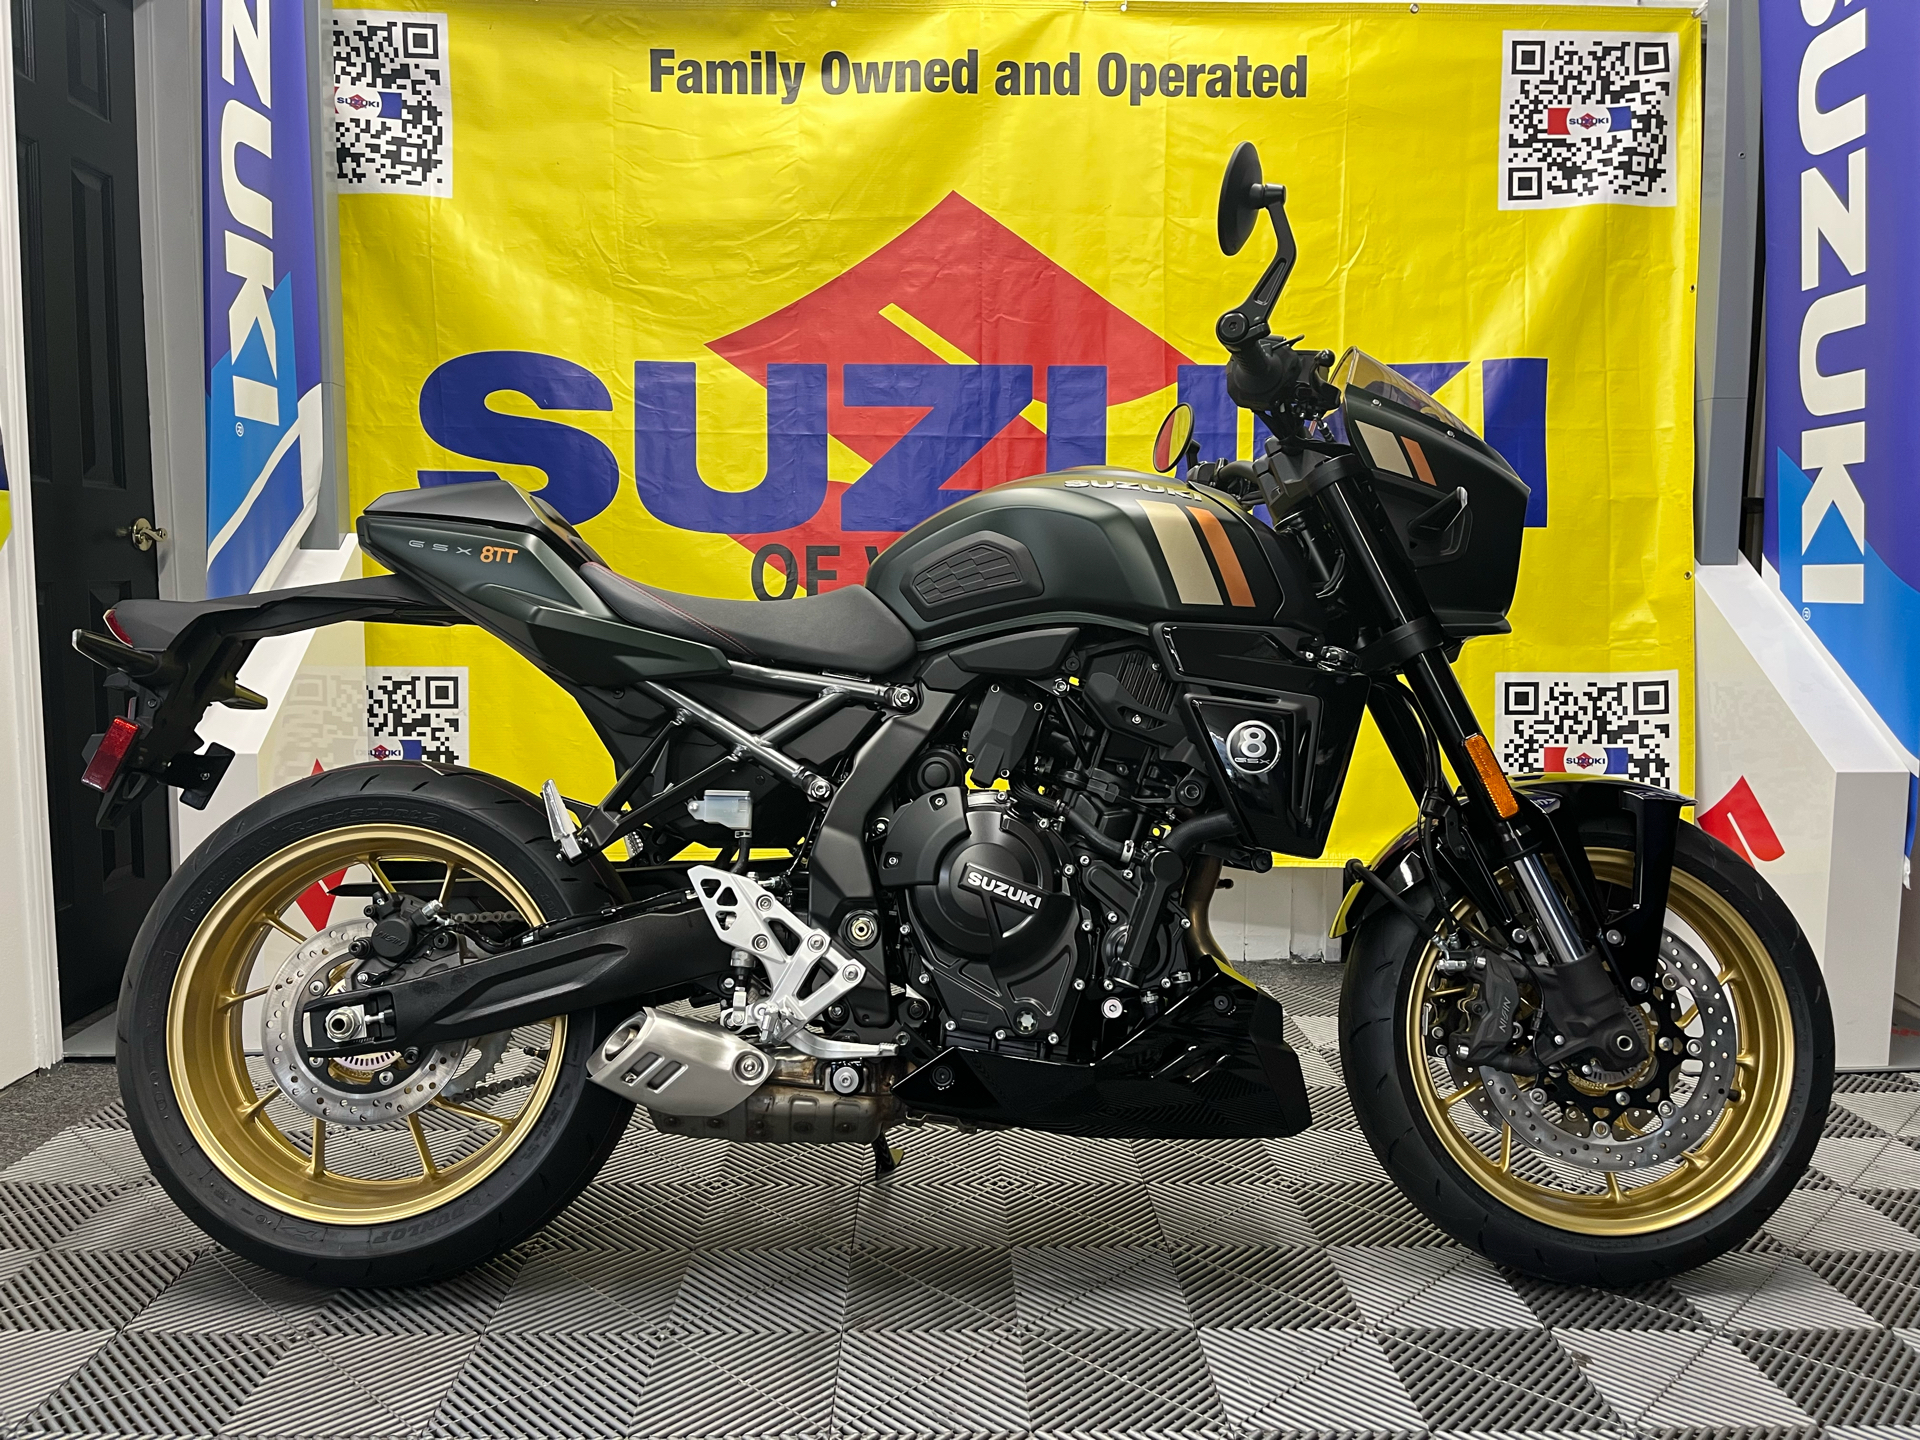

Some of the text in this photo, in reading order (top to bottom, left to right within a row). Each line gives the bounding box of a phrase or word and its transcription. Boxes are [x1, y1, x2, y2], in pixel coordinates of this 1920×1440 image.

[649, 48, 1308, 106] Family Owned and Operated
[1798, 0, 1867, 604] UZUKI
[1064, 479, 1203, 502] SUZUKI
[480, 545, 519, 564] 8TT
[751, 543, 841, 601] OF
[368, 749, 401, 757] UZUKI
[1240, 727, 1267, 758] 8
[967, 871, 1042, 910] SUZUKI
